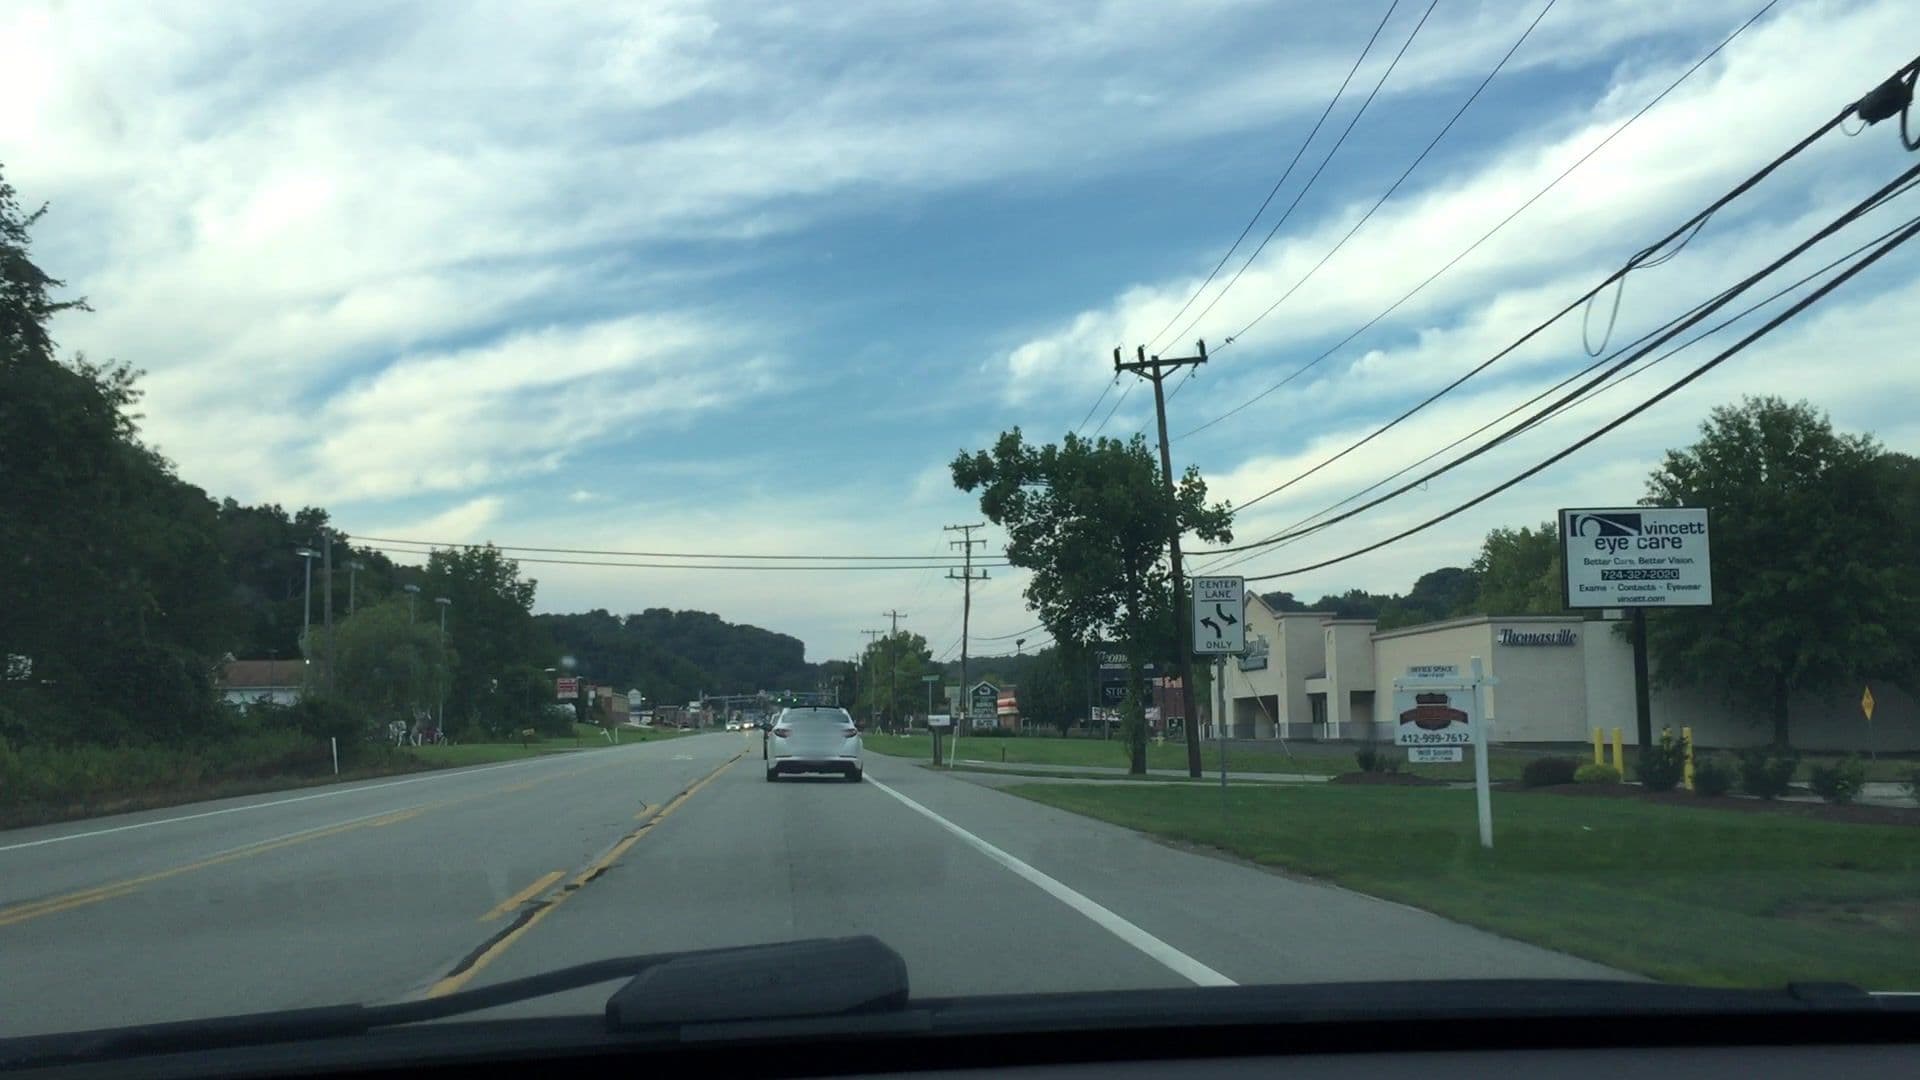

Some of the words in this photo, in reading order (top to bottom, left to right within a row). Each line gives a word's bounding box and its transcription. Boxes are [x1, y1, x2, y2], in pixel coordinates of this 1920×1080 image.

[1643, 520, 1705, 535] vincett
[1594, 537, 1629, 555] eye
[1637, 536, 1683, 549] care
[1583, 558, 1611, 566] Better
[1638, 557, 1666, 565] Better
[1603, 569, 1679, 580] 724-327-2020
[1199, 580, 1237, 589] CENTER
[1617, 584, 1657, 592] Contacts
[1667, 583, 1702, 592] Eyewear
[1205, 590, 1232, 598] LANE
[1617, 595, 1665, 603] vincett.com
[1497, 628, 1577, 646] Thomasville
[1206, 641, 1232, 649] ONLY
[1400, 733, 1469, 743] 412-999-7612
